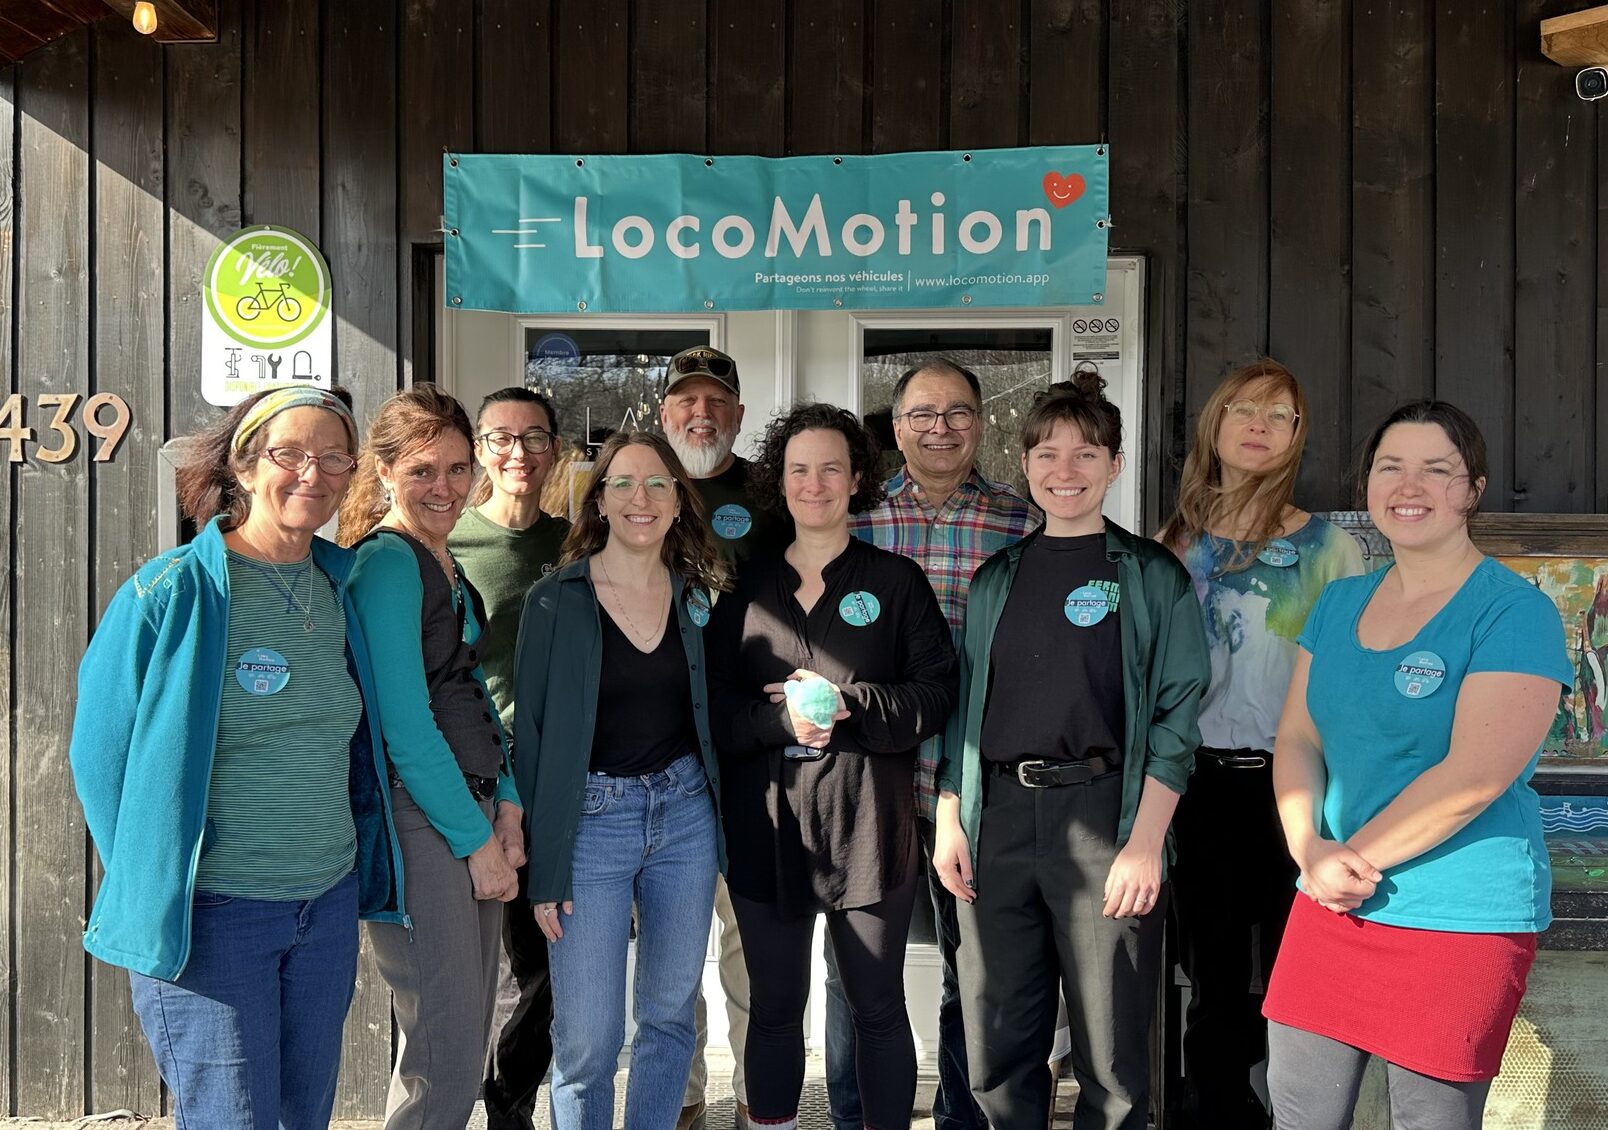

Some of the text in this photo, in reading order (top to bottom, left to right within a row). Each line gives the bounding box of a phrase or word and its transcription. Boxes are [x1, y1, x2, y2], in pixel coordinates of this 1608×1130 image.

[574, 191, 1052, 260] LocoMotion
[755, 270, 904, 285] Partageons nos véhicules
[915, 272, 1050, 287] www.locomotion.app
[0, 392, 130, 462] 439
[724, 516, 750, 524] partage
[856, 600, 871, 623] partage
[1067, 599, 1075, 607] Je
[1077, 600, 1106, 609] partage
[239, 661, 287, 674] Je partage
[1399, 664, 1442, 678] Je partage
